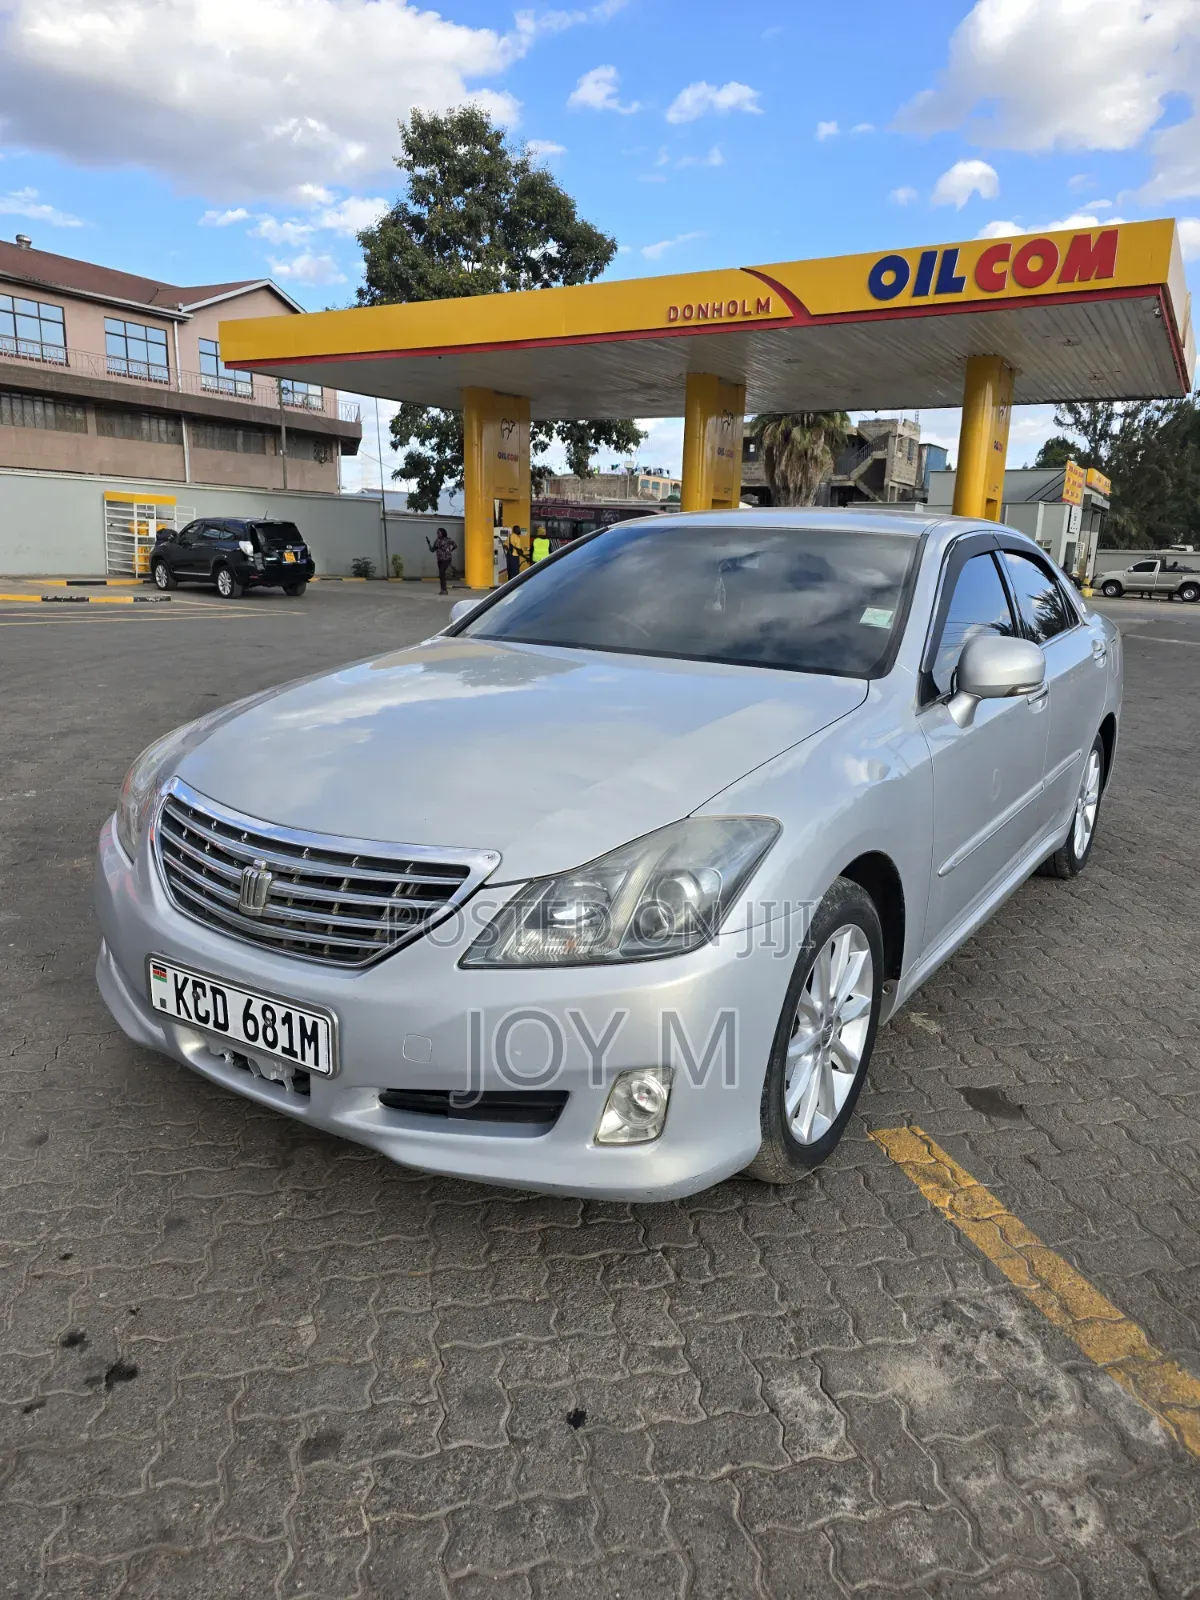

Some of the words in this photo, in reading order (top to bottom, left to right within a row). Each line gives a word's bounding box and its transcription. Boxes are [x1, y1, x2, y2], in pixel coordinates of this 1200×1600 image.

[868, 229, 1119, 300] OILCOM
[668, 297, 773, 321] DONHOLM
[173, 973, 230, 1032] KCD
[242, 998, 320, 1067] 681M
